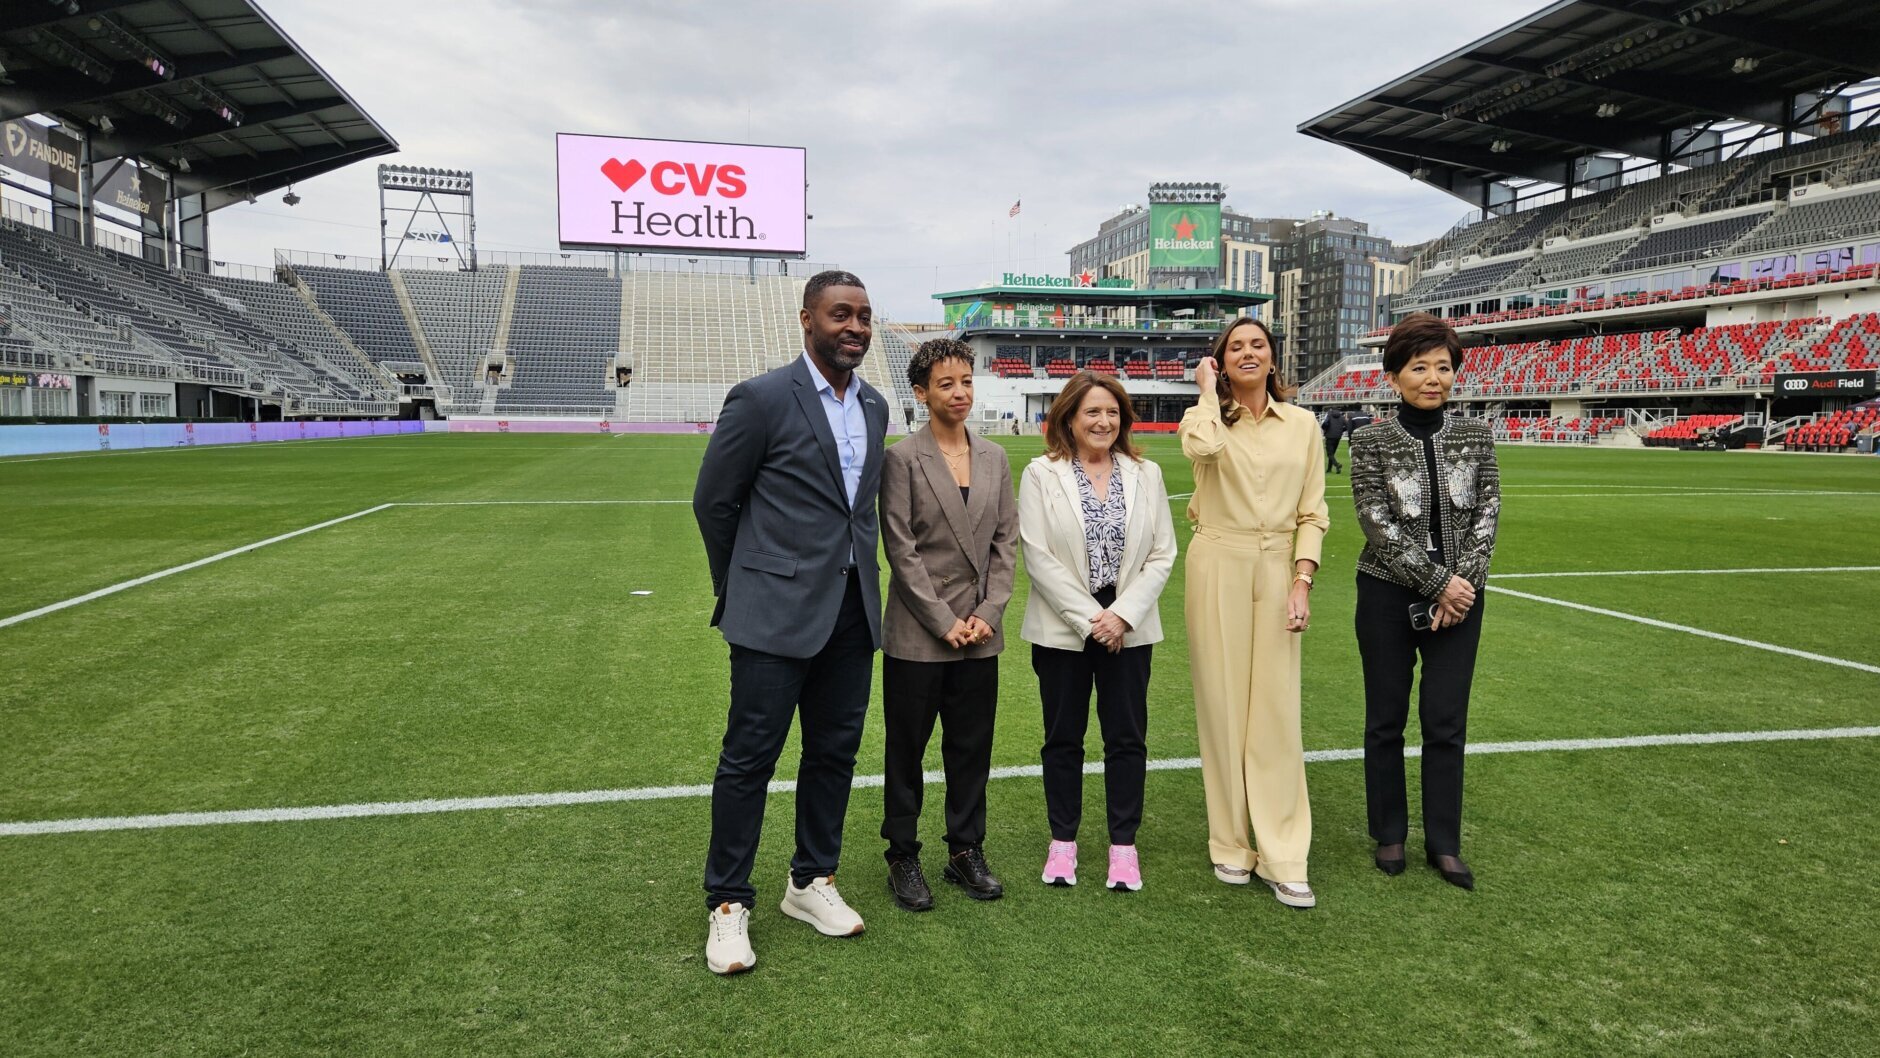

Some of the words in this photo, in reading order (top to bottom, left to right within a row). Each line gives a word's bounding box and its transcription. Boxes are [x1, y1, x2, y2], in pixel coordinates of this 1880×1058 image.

[29, 139, 77, 174] FANDUEL
[650, 161, 747, 198] CVS
[116, 189, 151, 214] Heineken
[1154, 237, 1215, 250] Heineken
[1002, 272, 1073, 287] Heineken
[1016, 303, 1055, 312] Heineken
[1812, 380, 1836, 388] Audi
[1838, 379, 1864, 388] Field
